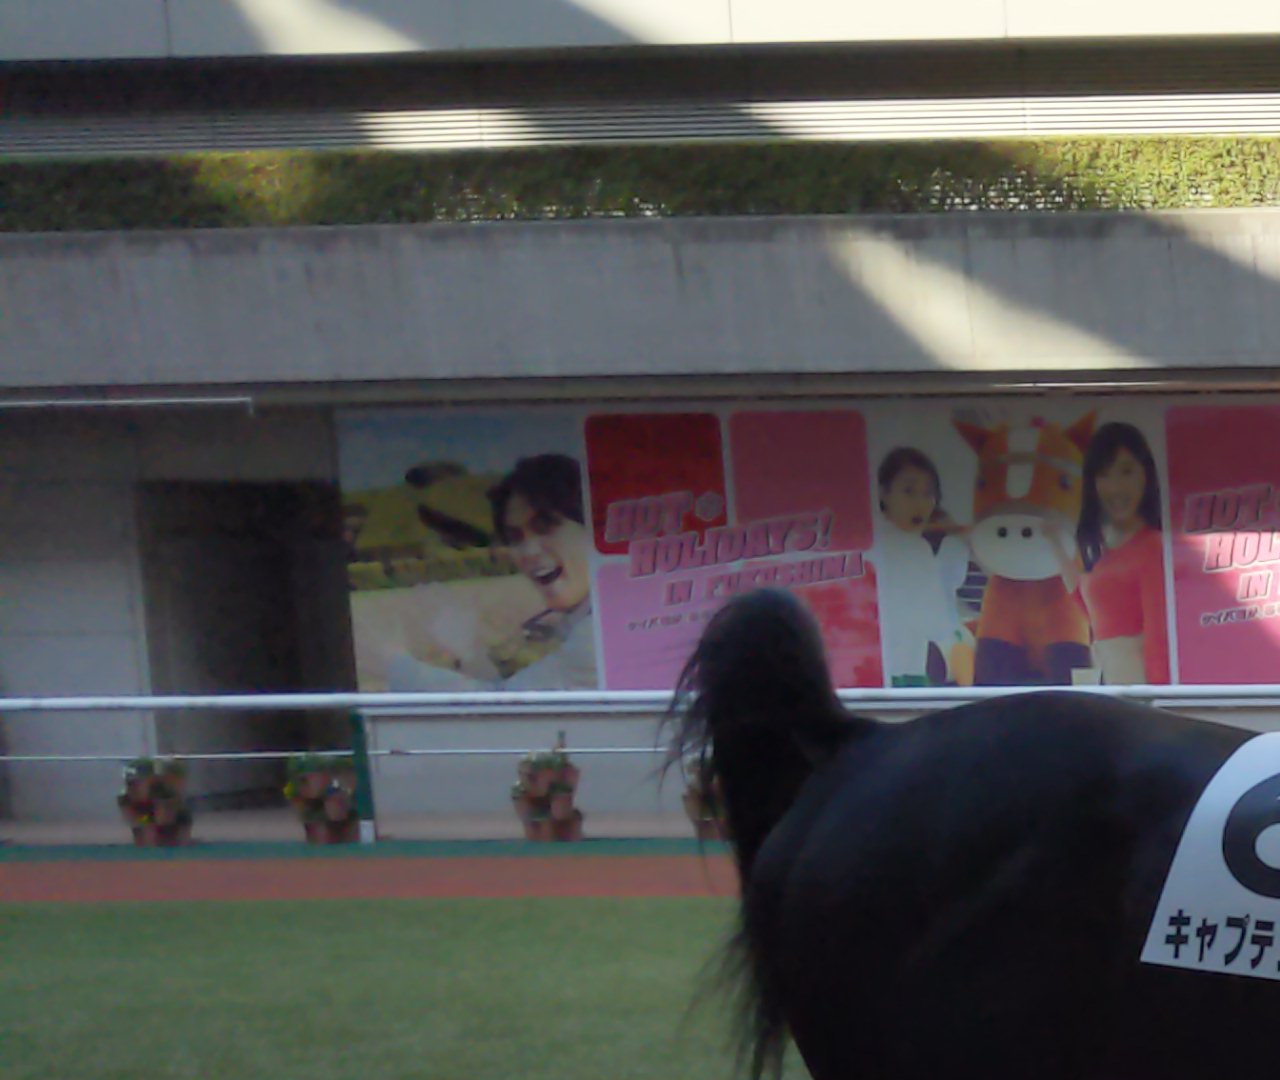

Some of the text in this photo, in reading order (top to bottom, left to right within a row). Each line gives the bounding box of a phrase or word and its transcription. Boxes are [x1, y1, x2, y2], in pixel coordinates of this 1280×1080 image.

[606, 492, 690, 541] HOT
[1185, 485, 1271, 533] HOT
[630, 511, 832, 576] HOLIDAYS!
[664, 580, 693, 606] IN
[1239, 573, 1270, 599] IN
